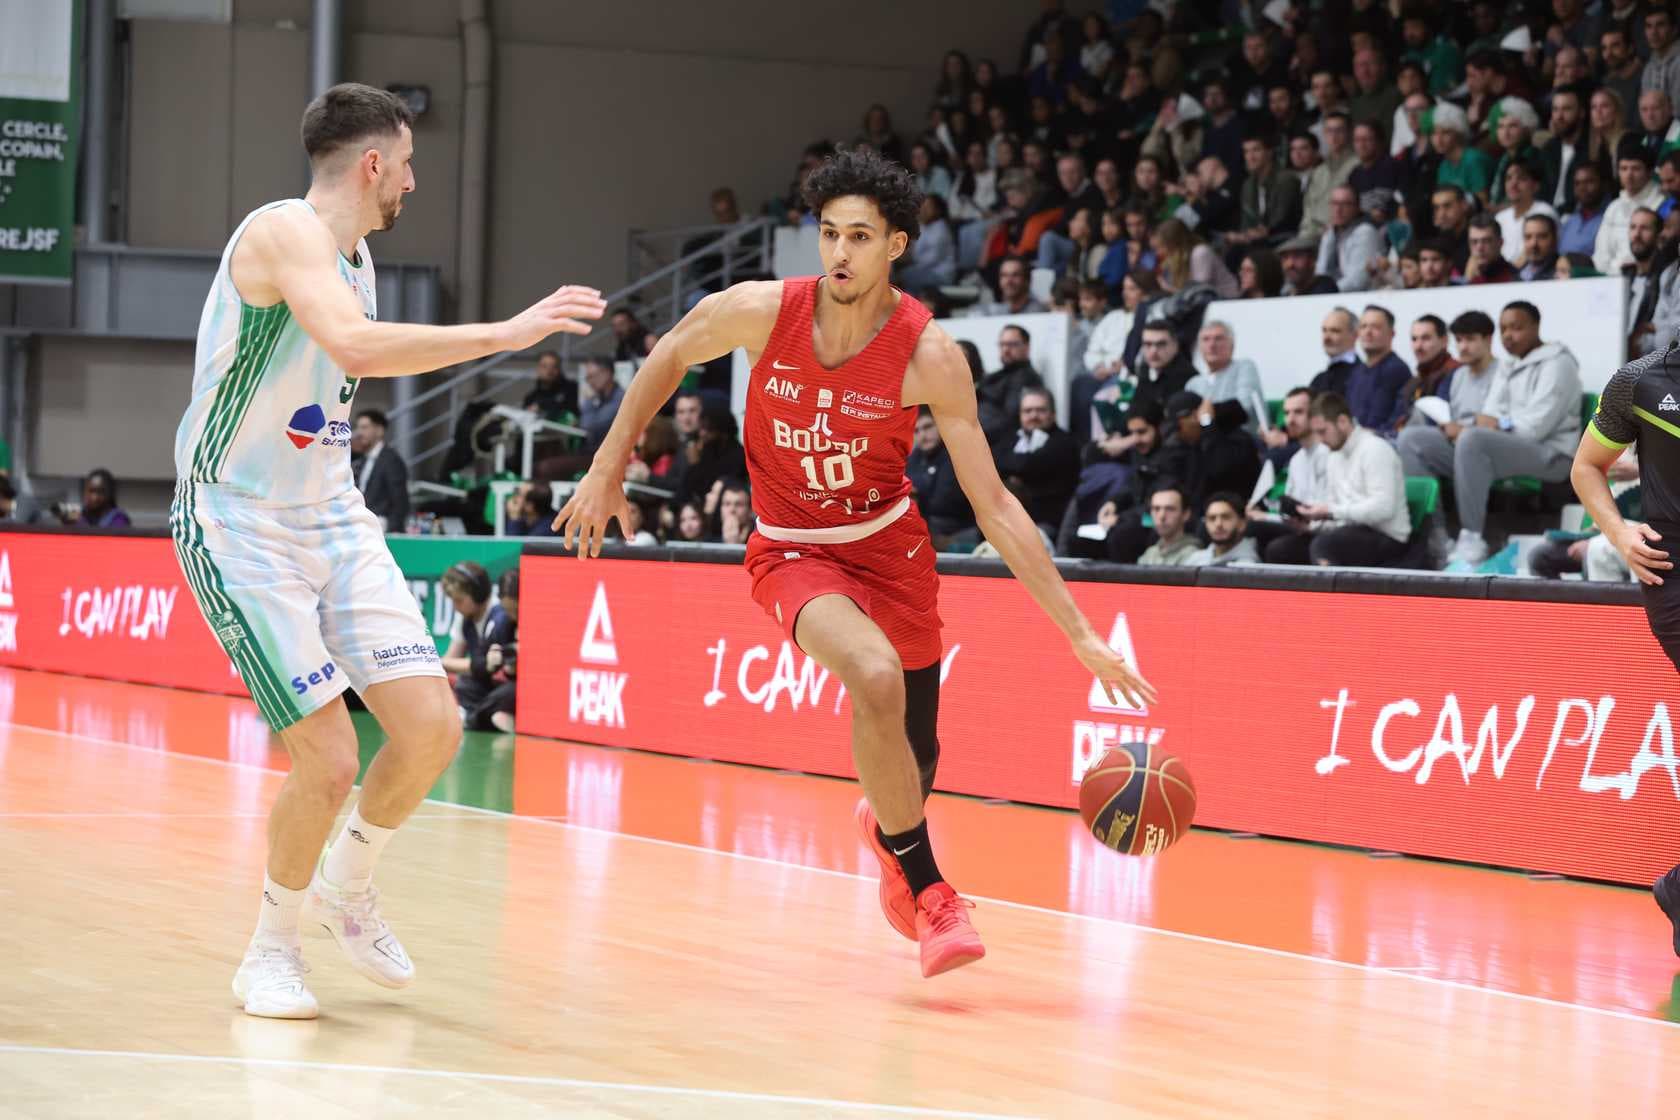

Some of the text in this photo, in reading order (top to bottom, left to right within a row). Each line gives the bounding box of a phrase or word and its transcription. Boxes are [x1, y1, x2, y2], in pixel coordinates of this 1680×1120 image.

[1658, 403, 1680, 411] PEAK
[801, 453, 855, 490] 10
[291, 662, 335, 695] Sep
[569, 667, 629, 729] PEAK
[737, 640, 829, 713] CAN
[1315, 688, 1356, 775] I
[1371, 693, 1536, 785] CAN
